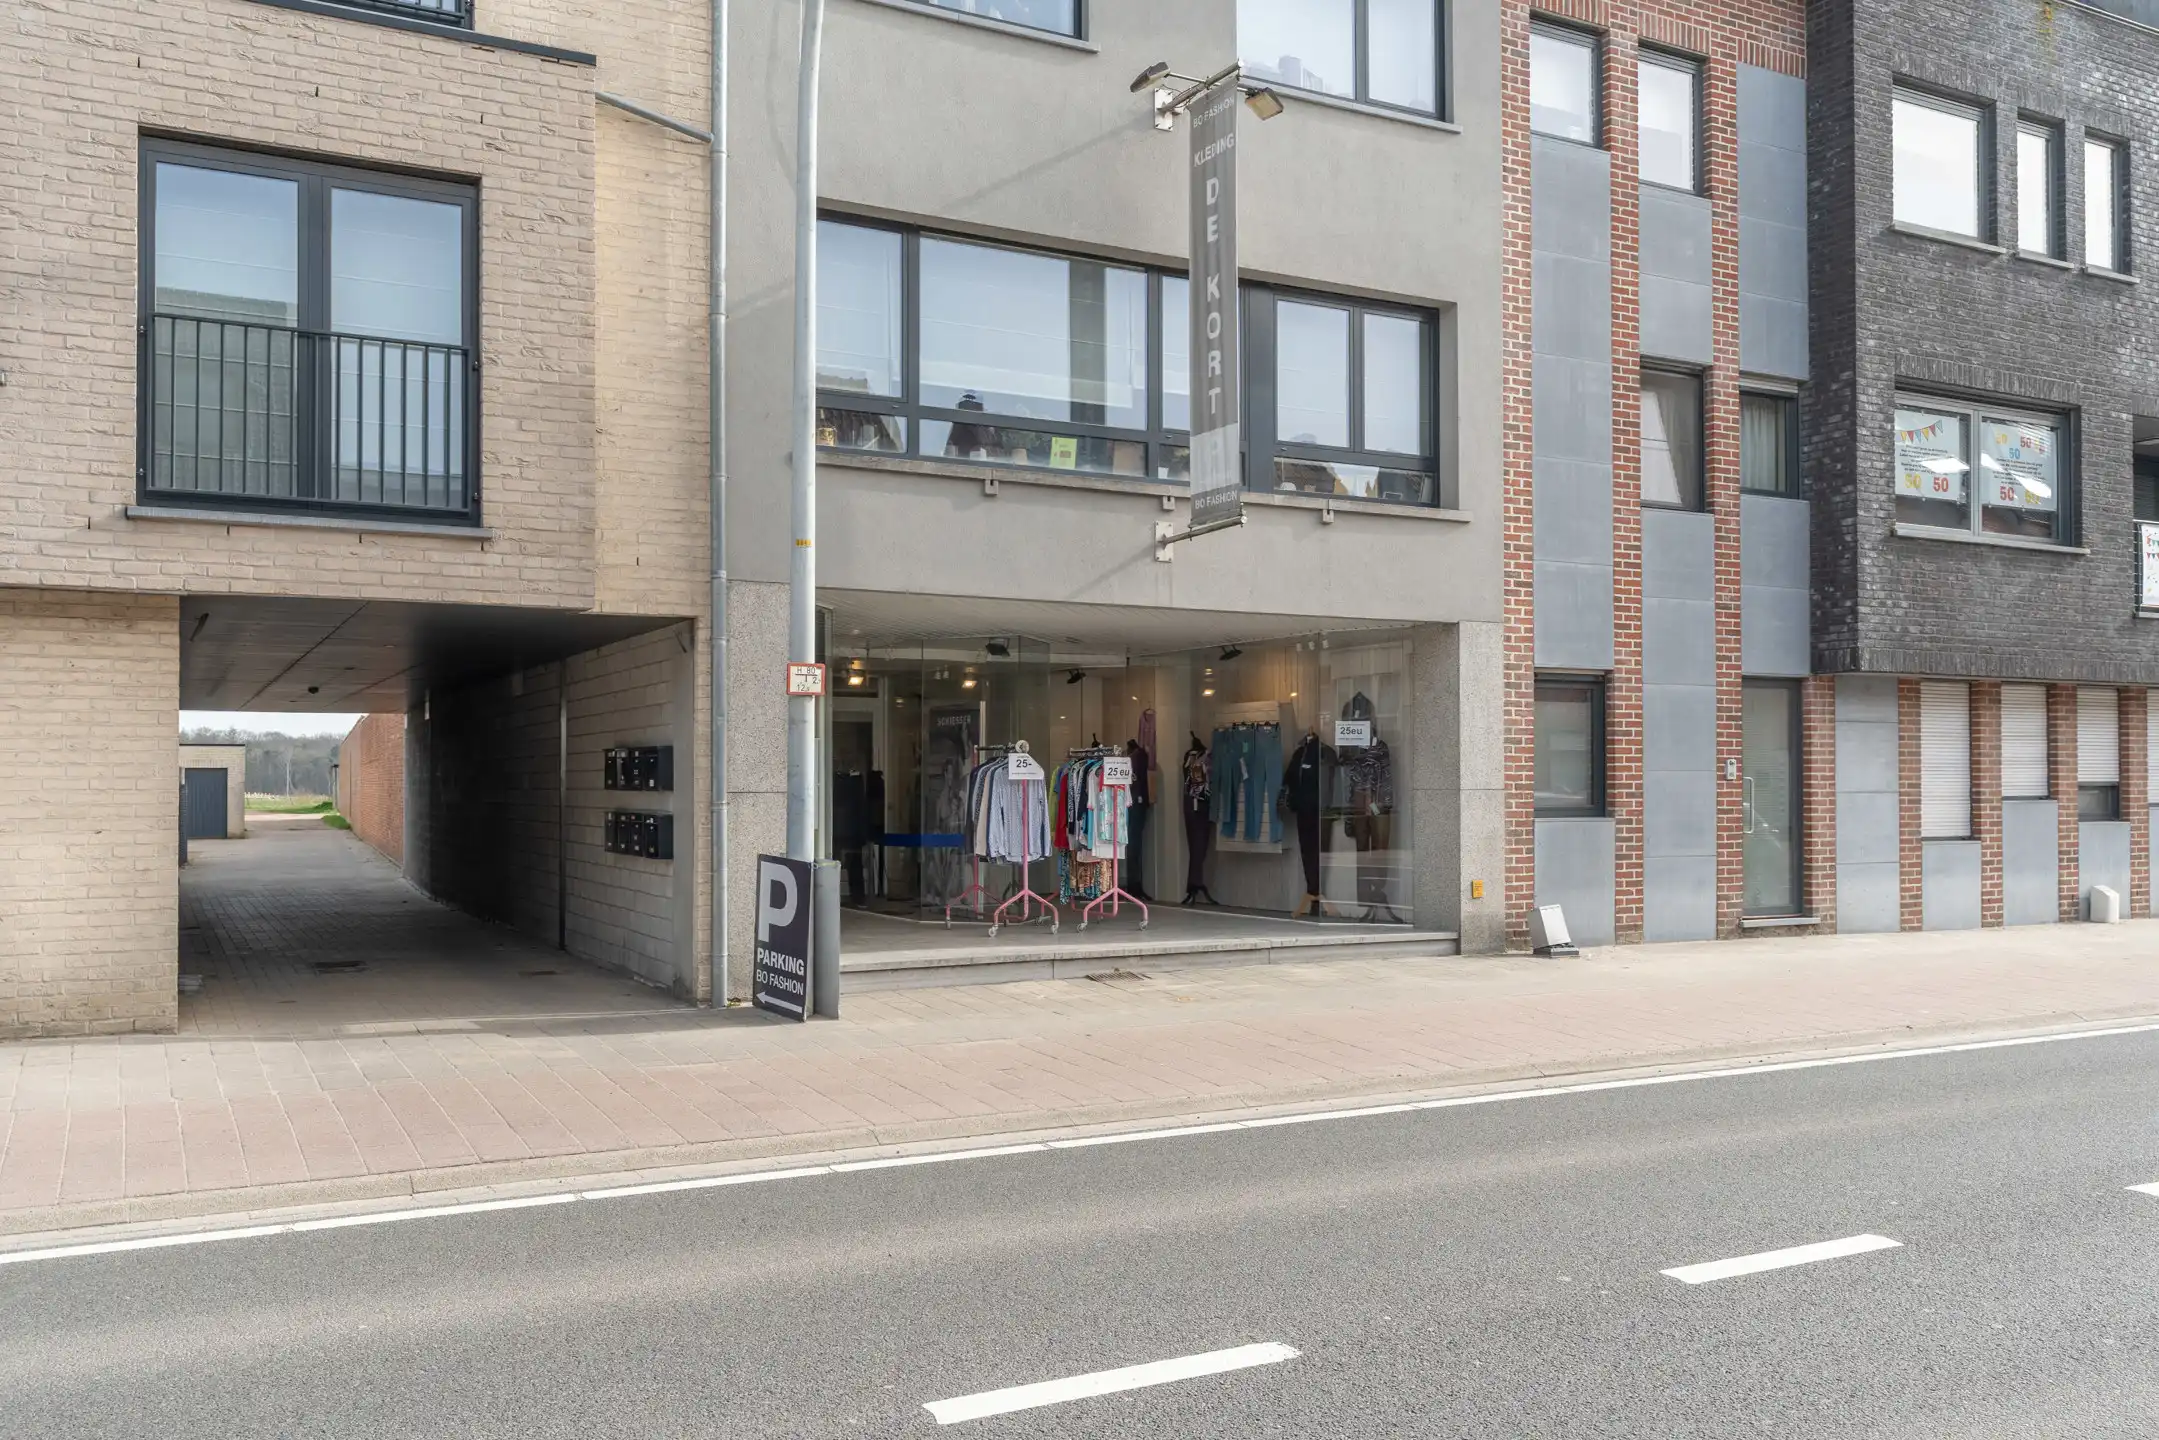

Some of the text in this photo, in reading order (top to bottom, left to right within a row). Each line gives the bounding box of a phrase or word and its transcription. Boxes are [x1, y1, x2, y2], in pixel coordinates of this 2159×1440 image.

[1193, 114, 1203, 128] BO
[1194, 132, 1234, 167] KLEDING
[1206, 177, 1221, 415] DE KORT
[2009, 447, 2020, 459] 50
[1904, 473, 1921, 488] 50
[1933, 476, 1949, 492] 50
[1195, 489, 1238, 509] BO FASHION
[2000, 485, 2015, 501] 50
[807, 666, 816, 674] 80
[1107, 767, 1118, 776] 25
[757, 861, 798, 943] P
[757, 947, 805, 976] PARKING
[756, 968, 804, 996] BO FASHION
